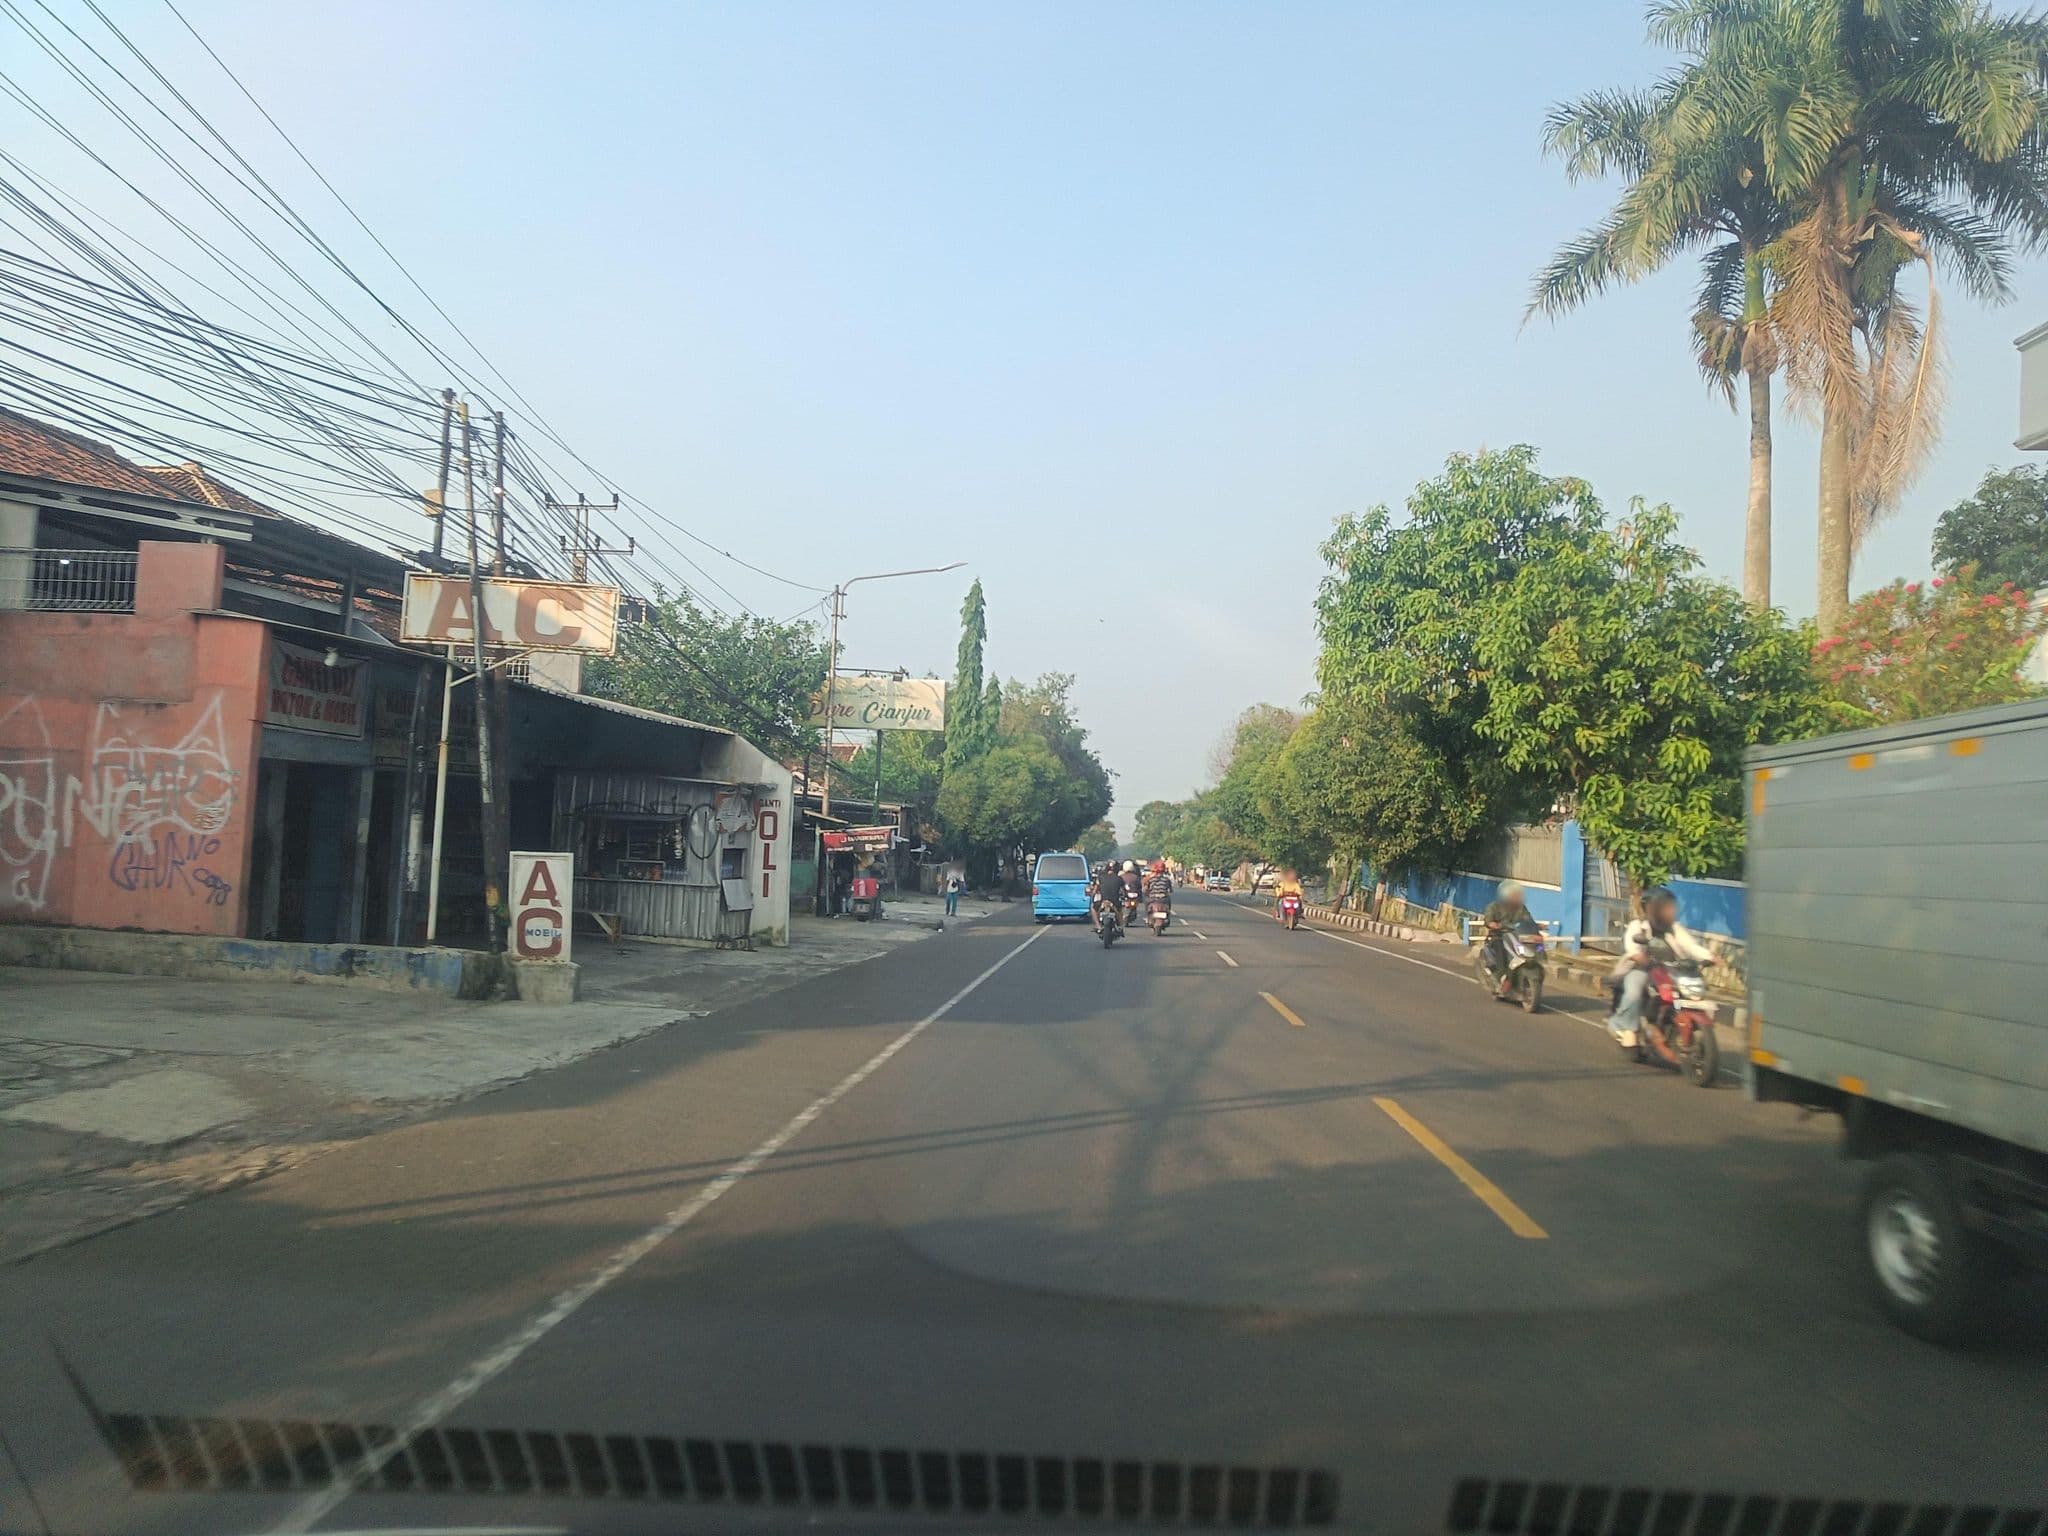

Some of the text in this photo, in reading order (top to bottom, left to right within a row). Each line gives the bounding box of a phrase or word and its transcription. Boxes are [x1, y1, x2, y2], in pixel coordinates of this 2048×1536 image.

[426, 580, 584, 646] AC
[862, 701, 932, 726] Cianjur
[758, 810, 778, 898] OLI
[517, 860, 563, 957] AC
[525, 928, 562, 937] MOBIL
